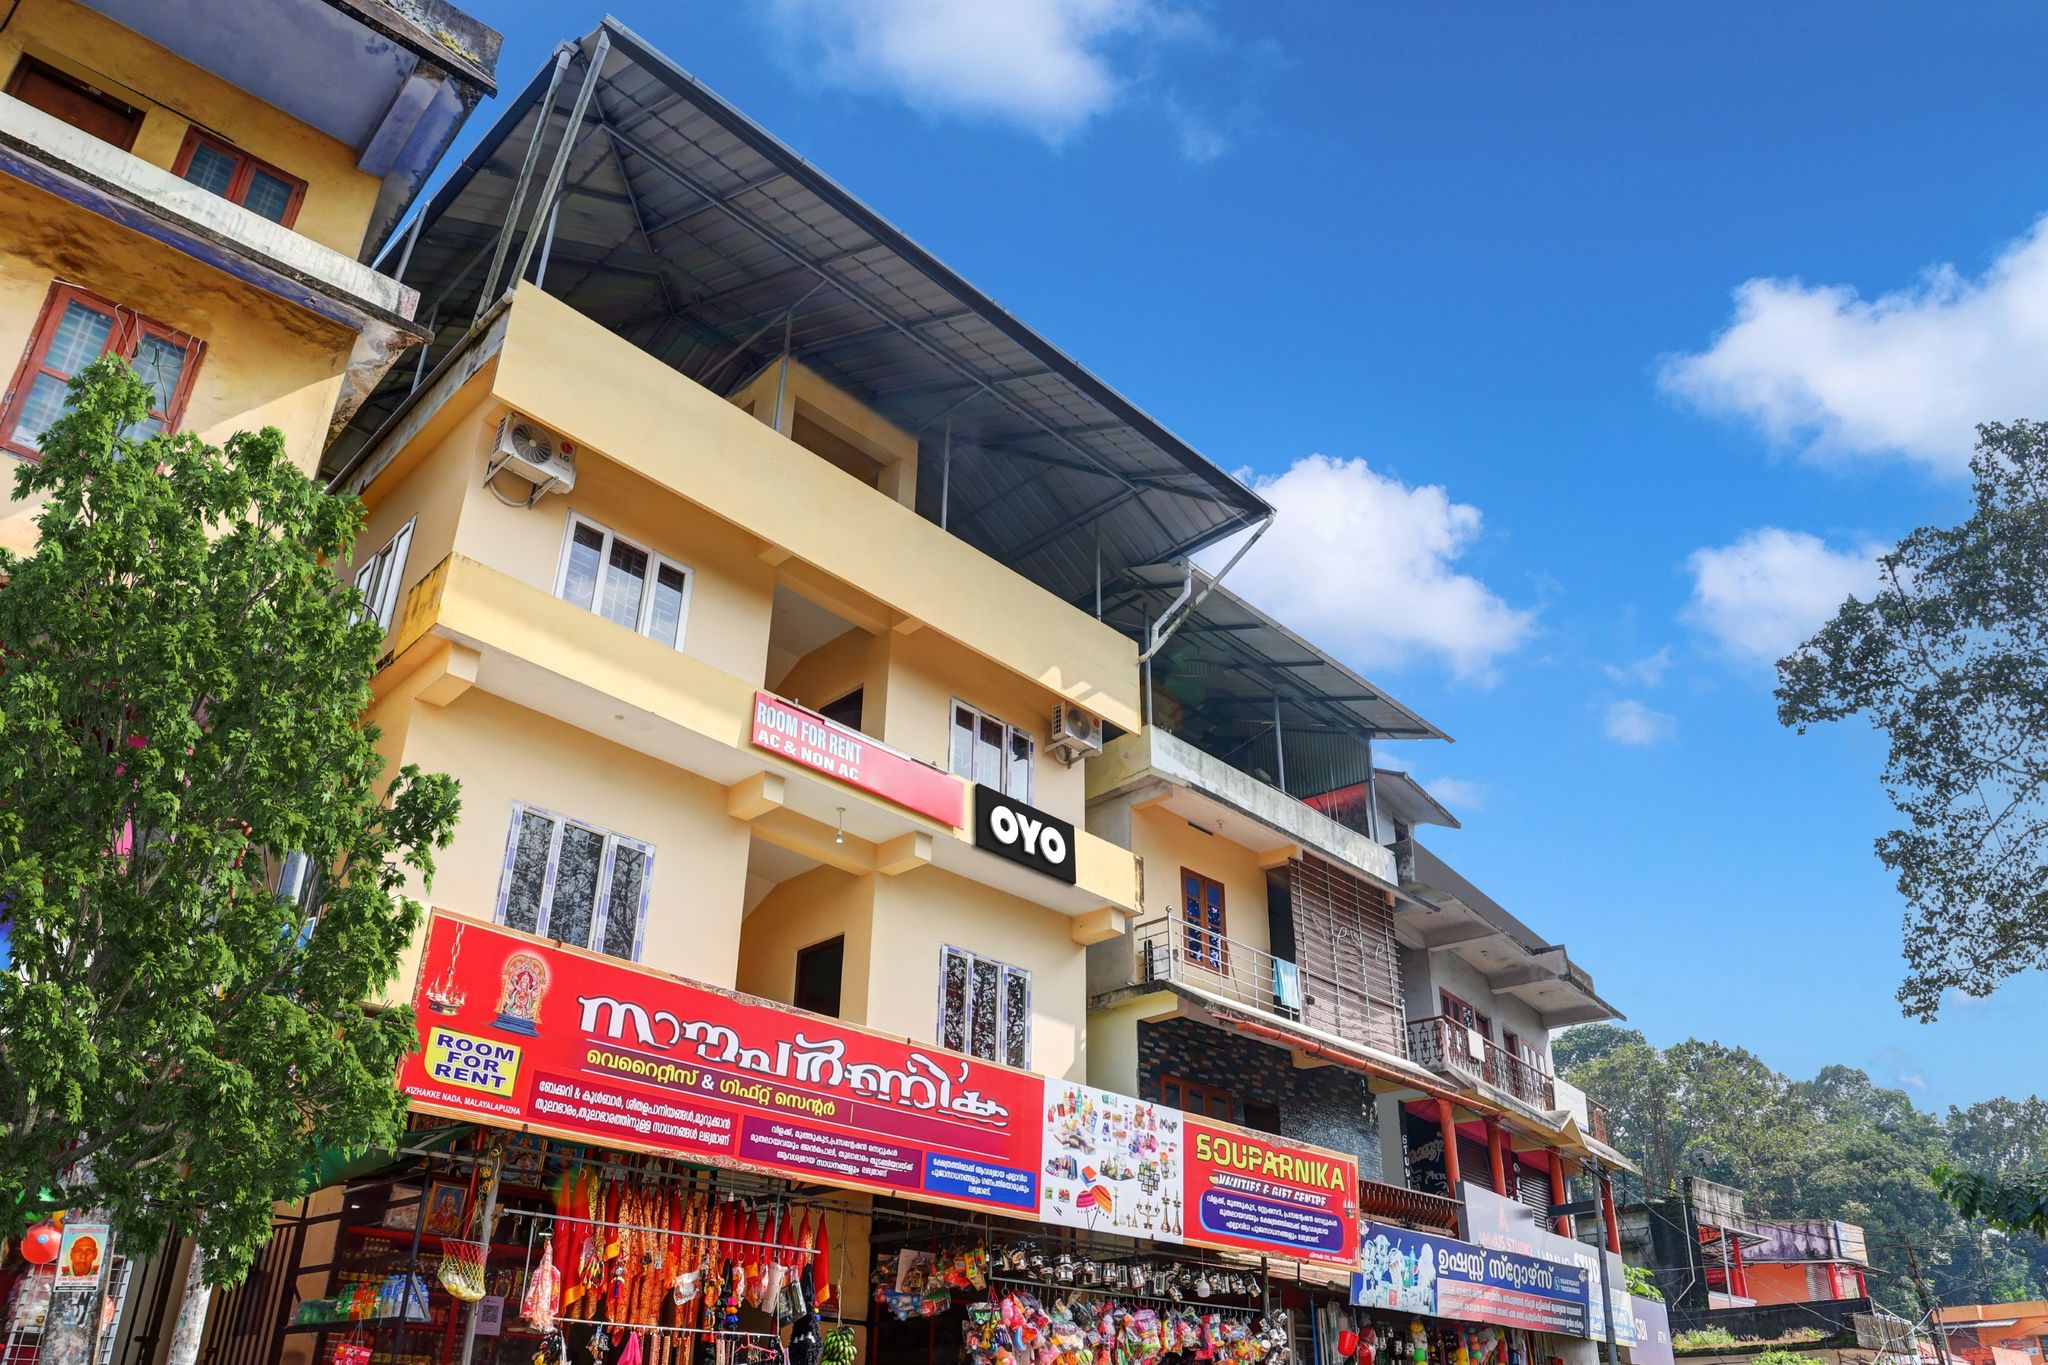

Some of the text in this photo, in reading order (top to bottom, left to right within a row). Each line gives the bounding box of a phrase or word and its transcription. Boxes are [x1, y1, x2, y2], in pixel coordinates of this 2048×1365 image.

[757, 701, 863, 765] ROOM FOR RENT
[758, 729, 859, 781] AC & NON AC
[990, 806, 1066, 865] OYO
[436, 1033, 515, 1062] ROOM
[446, 1050, 500, 1073] FOR
[434, 1063, 507, 1088] RENT
[700, 1074, 715, 1090] &
[405, 1086, 521, 1116] KIZHAKKE NADA, MALAYALAPUZHA
[574, 1088, 581, 1100] &
[1197, 1134, 1345, 1192] SOUPARNIKA
[1271, 1185, 1293, 1199] GIFT
[1294, 1190, 1327, 1206] CENTRE
